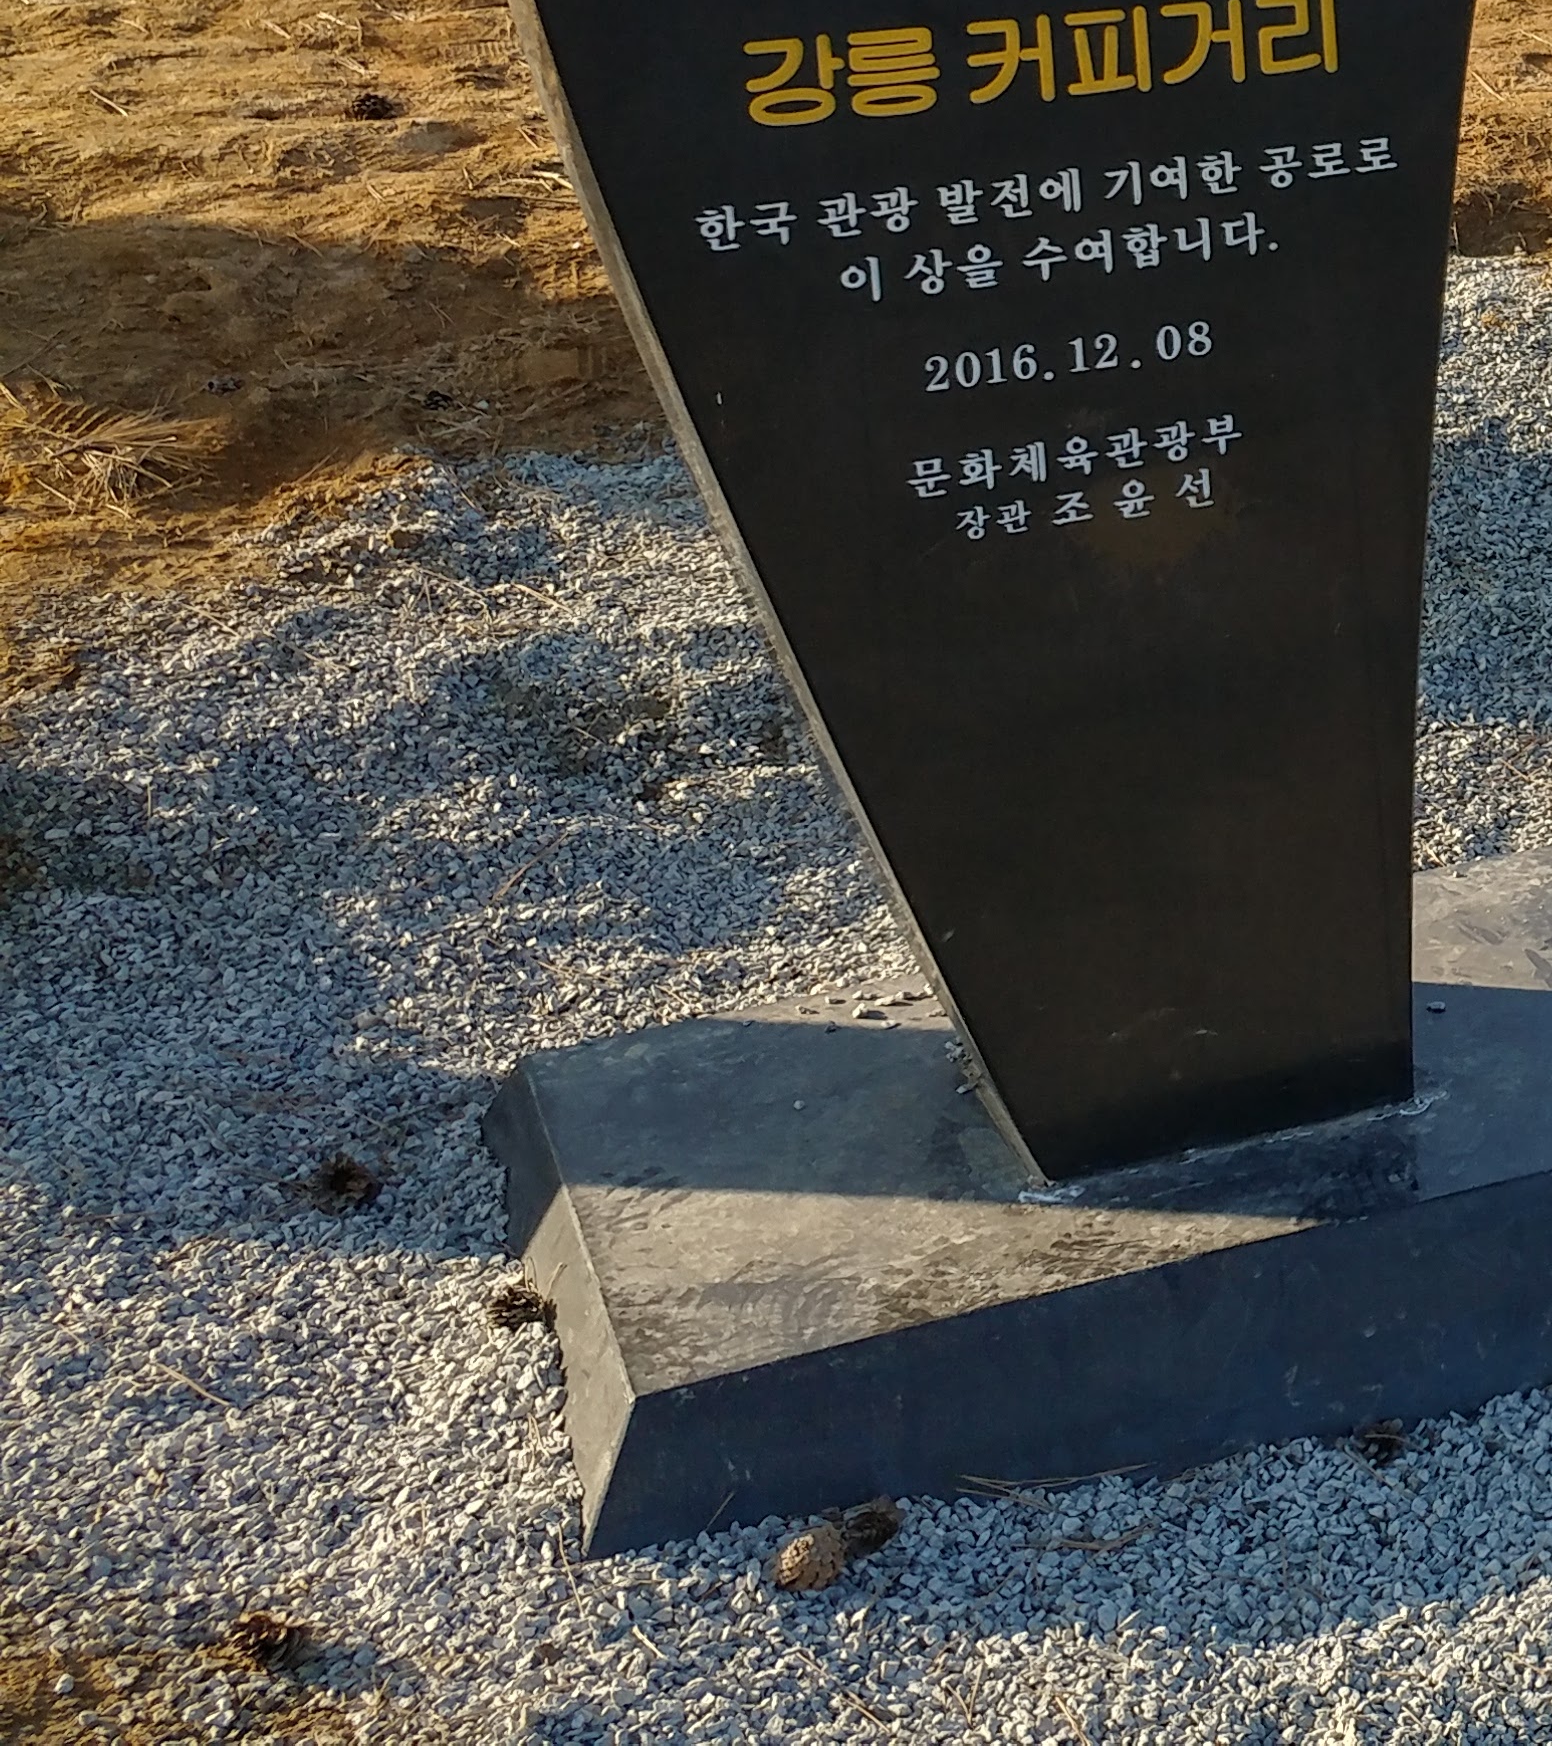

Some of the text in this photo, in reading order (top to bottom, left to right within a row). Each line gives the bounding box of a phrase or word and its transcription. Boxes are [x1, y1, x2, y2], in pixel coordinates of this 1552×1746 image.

[743, 27, 940, 126] 강릉
[695, 137, 1398, 251] 한국 관광 발전에 기여한 공로로
[840, 212, 1278, 302] 이 상을 수여합니다.
[906, 414, 1243, 499] 문화체육관광부
[956, 500, 1032, 541] 장관
